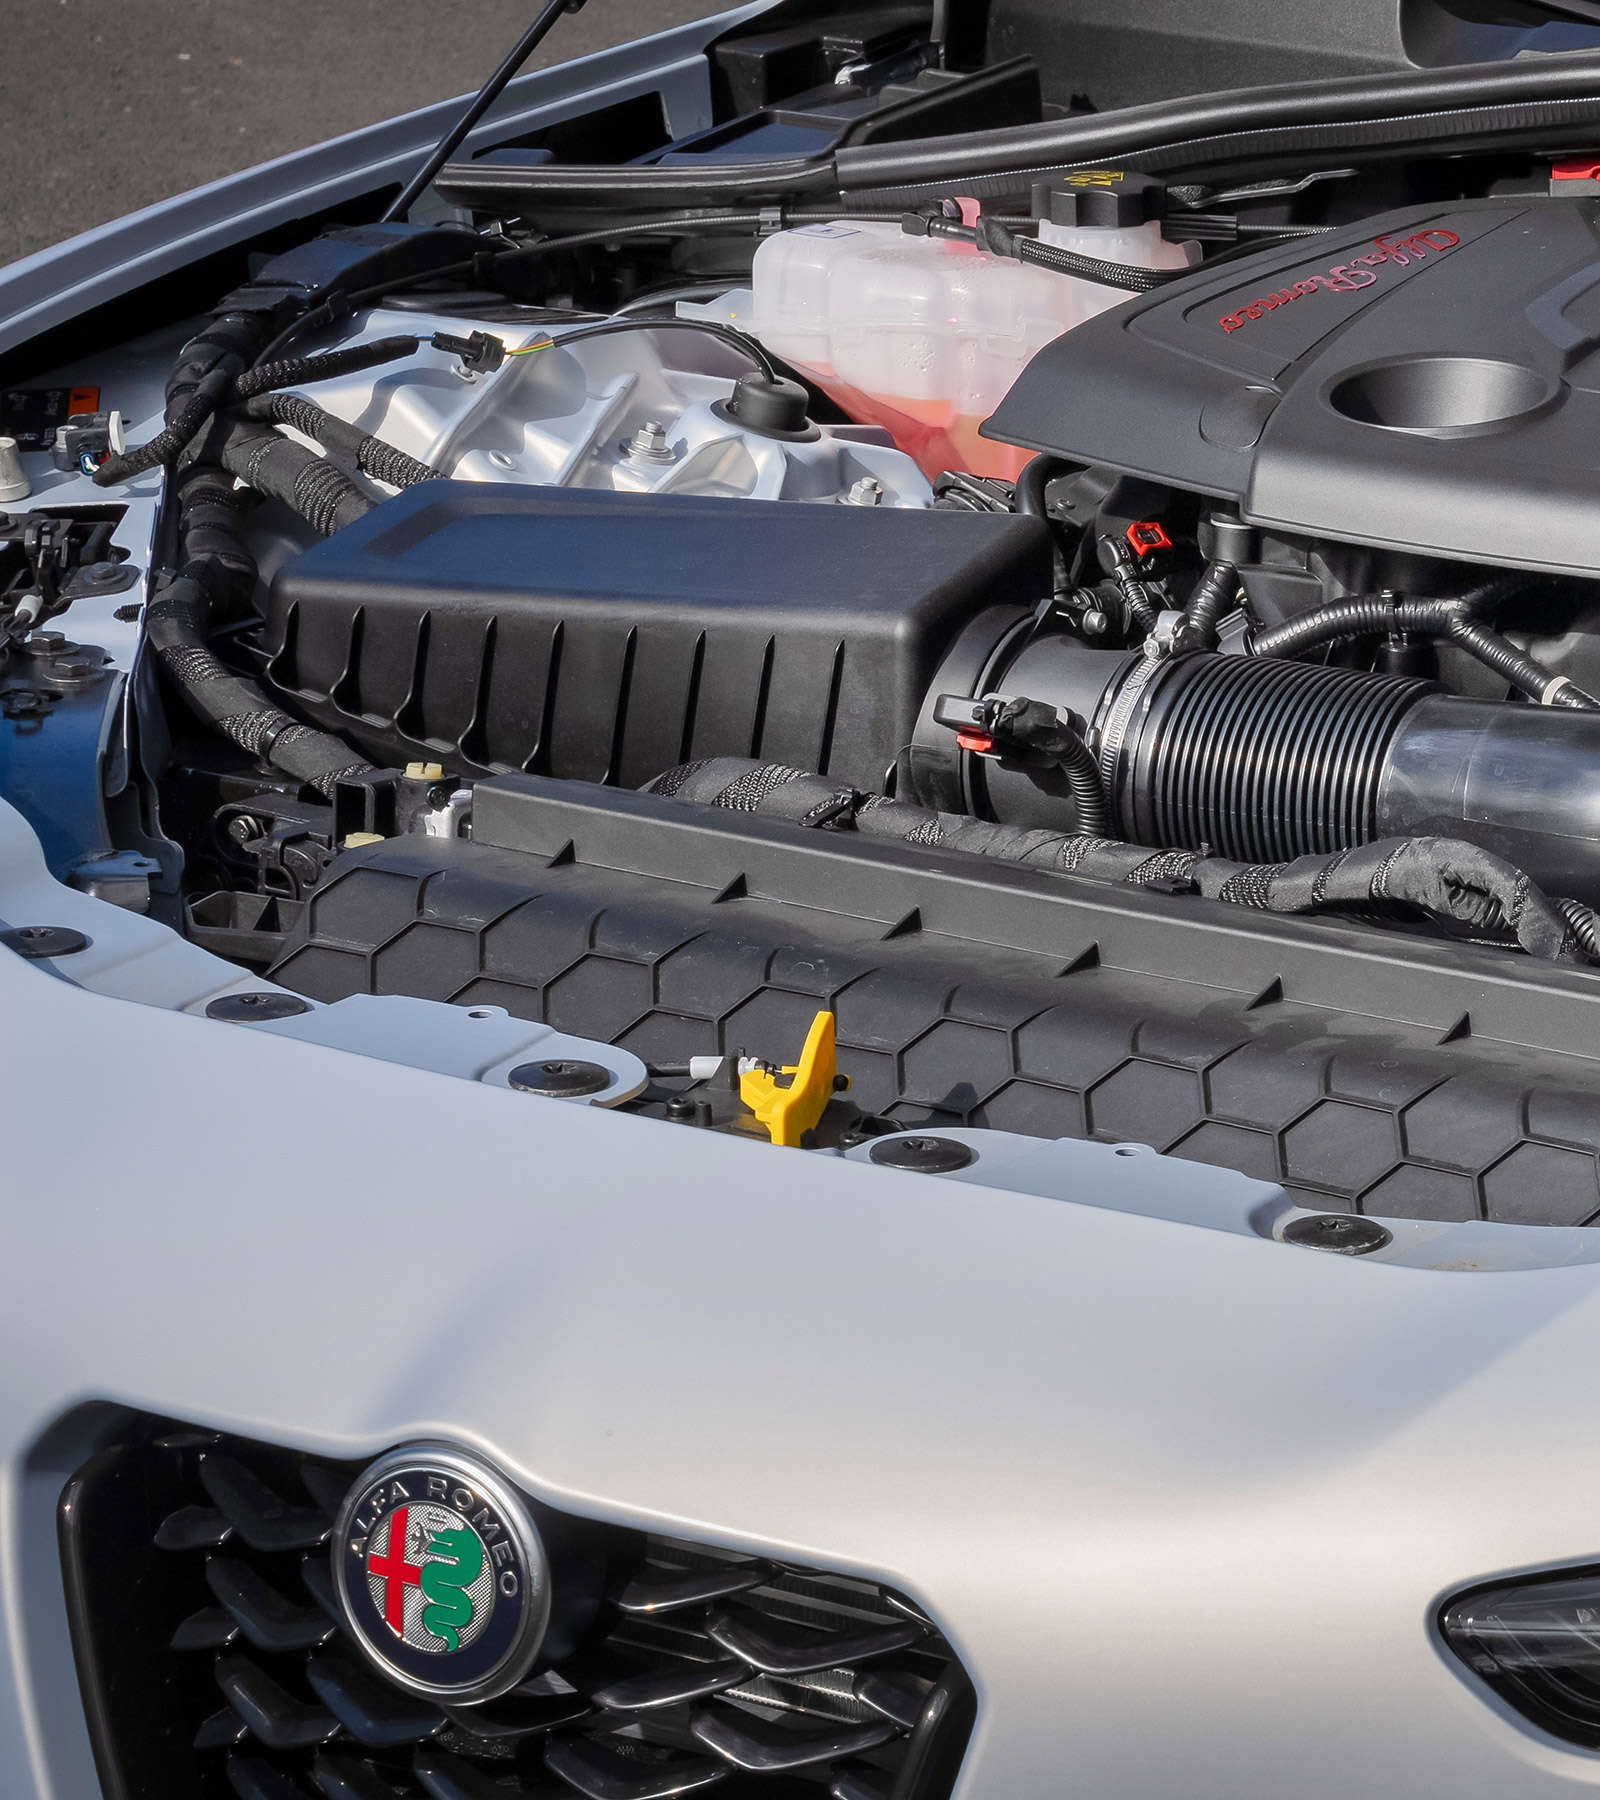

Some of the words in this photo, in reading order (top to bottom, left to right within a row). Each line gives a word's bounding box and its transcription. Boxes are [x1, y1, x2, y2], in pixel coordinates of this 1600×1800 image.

[1351, 229, 1460, 267] Alfa
[1219, 265, 1377, 334] Romeo
[350, 1481, 410, 1559] ALFA
[427, 1475, 519, 1598] ROMEO
